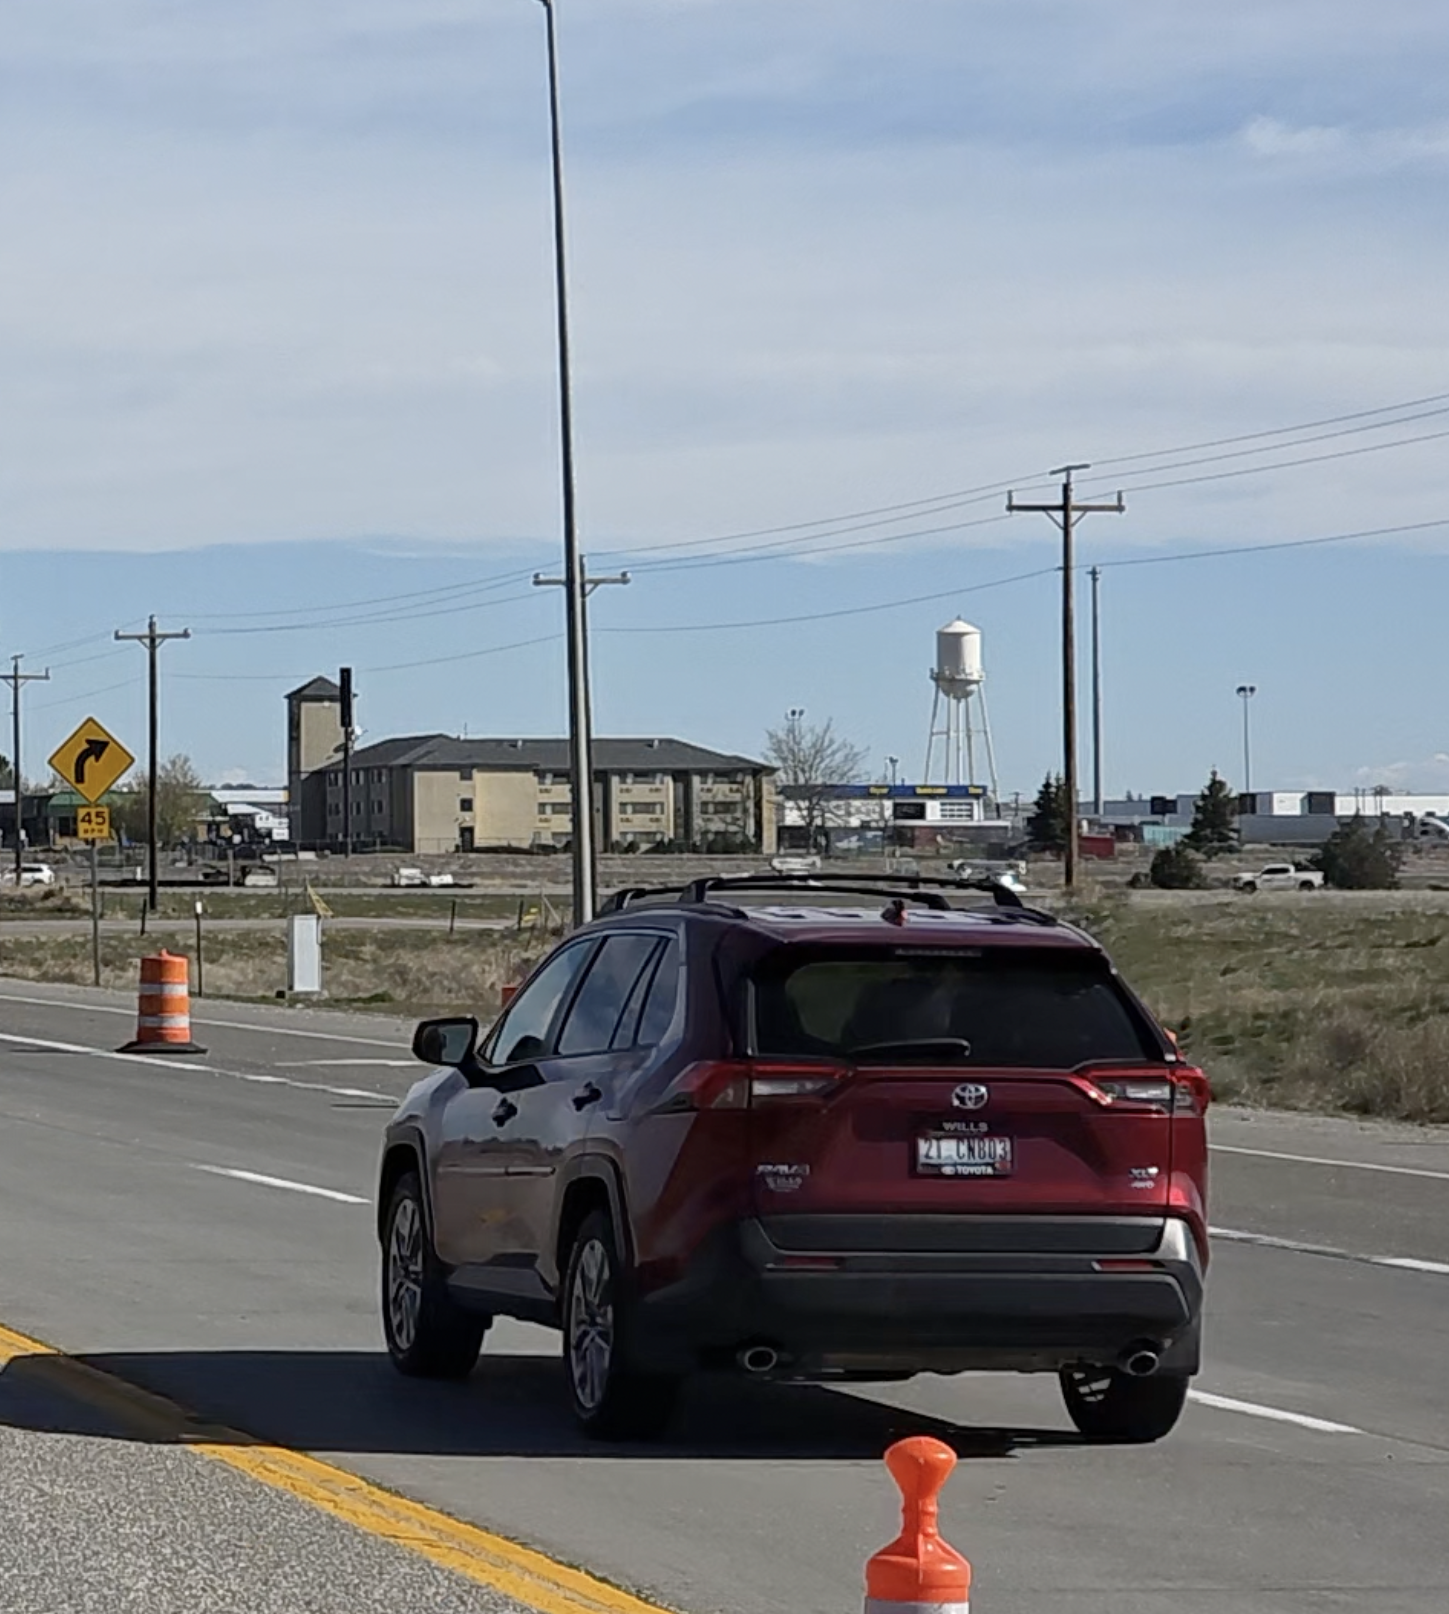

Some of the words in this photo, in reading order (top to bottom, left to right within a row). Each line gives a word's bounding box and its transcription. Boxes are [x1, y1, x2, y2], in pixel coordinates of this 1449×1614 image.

[80, 811, 106, 826] 45
[942, 1122, 989, 1132] WILLS
[956, 1165, 994, 1175] TOYOTA
